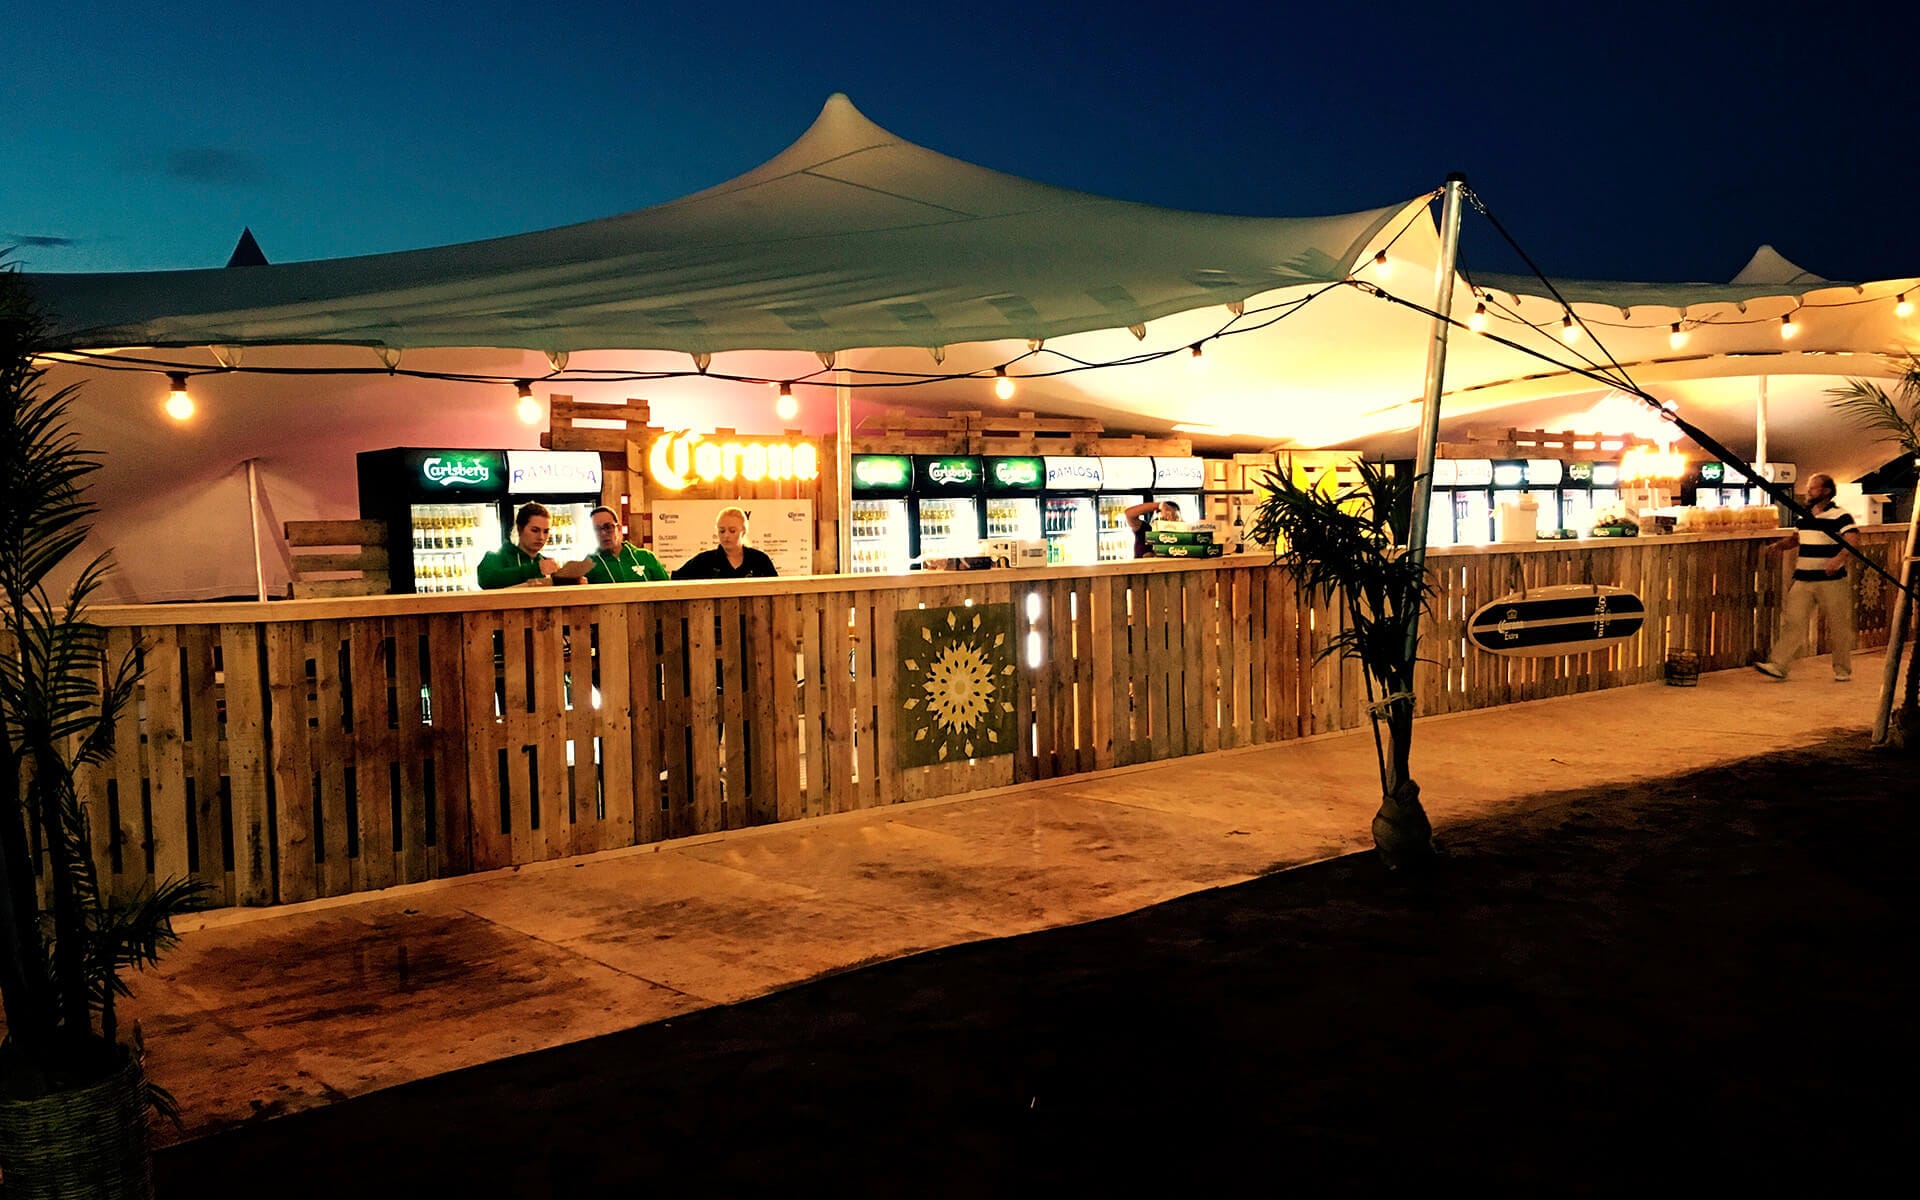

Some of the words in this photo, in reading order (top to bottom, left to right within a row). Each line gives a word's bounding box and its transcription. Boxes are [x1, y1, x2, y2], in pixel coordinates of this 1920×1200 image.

[423, 457, 489, 480] Carlsberg
[650, 430, 820, 490] Corona
[929, 462, 973, 481] Carlsberg
